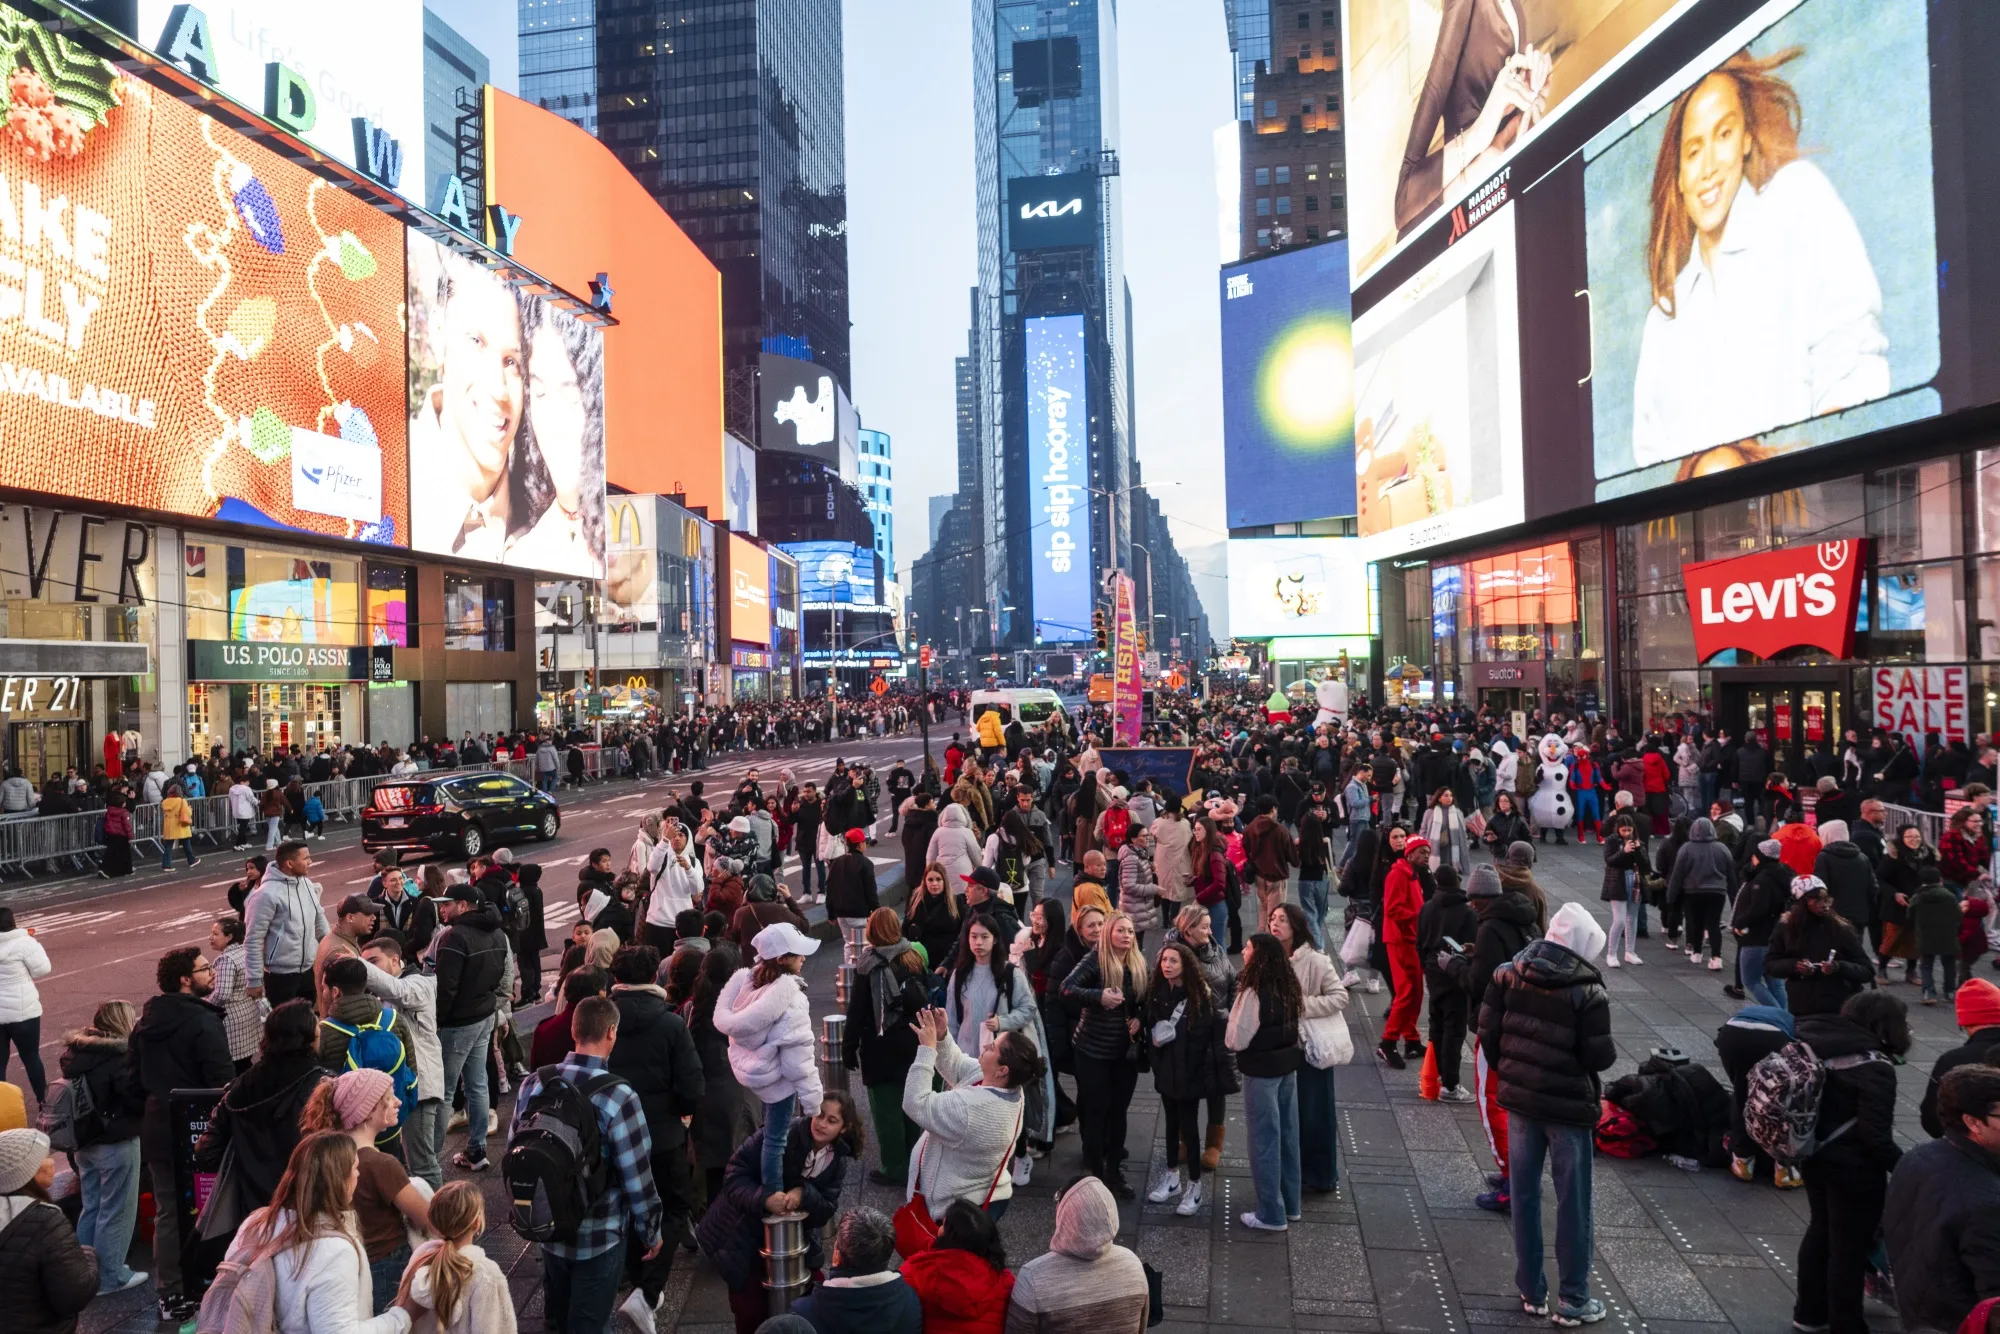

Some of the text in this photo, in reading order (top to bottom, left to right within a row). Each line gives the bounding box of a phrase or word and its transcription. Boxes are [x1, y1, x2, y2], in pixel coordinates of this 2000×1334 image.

[1468, 166, 1511, 210] MARRIOTT
[1021, 198, 1082, 219] KIA
[1468, 187, 1506, 225] MARQUIS
[0, 361, 157, 428] VAILABLE
[1043, 386, 1076, 573] sip sip hooray
[827, 483, 835, 519] 1500
[22, 505, 147, 607] VER
[223, 645, 351, 667] U.S. POLO ASSN.
[1117, 620, 1135, 685] WISH
[1147, 661, 1158, 669] 25
[269, 667, 309, 676] SINCE 1890
[1488, 667, 1518, 680] swatch
[1876, 667, 1964, 701] SALE
[51, 677, 80, 711] 21
[1877, 700, 1965, 735] SALE
